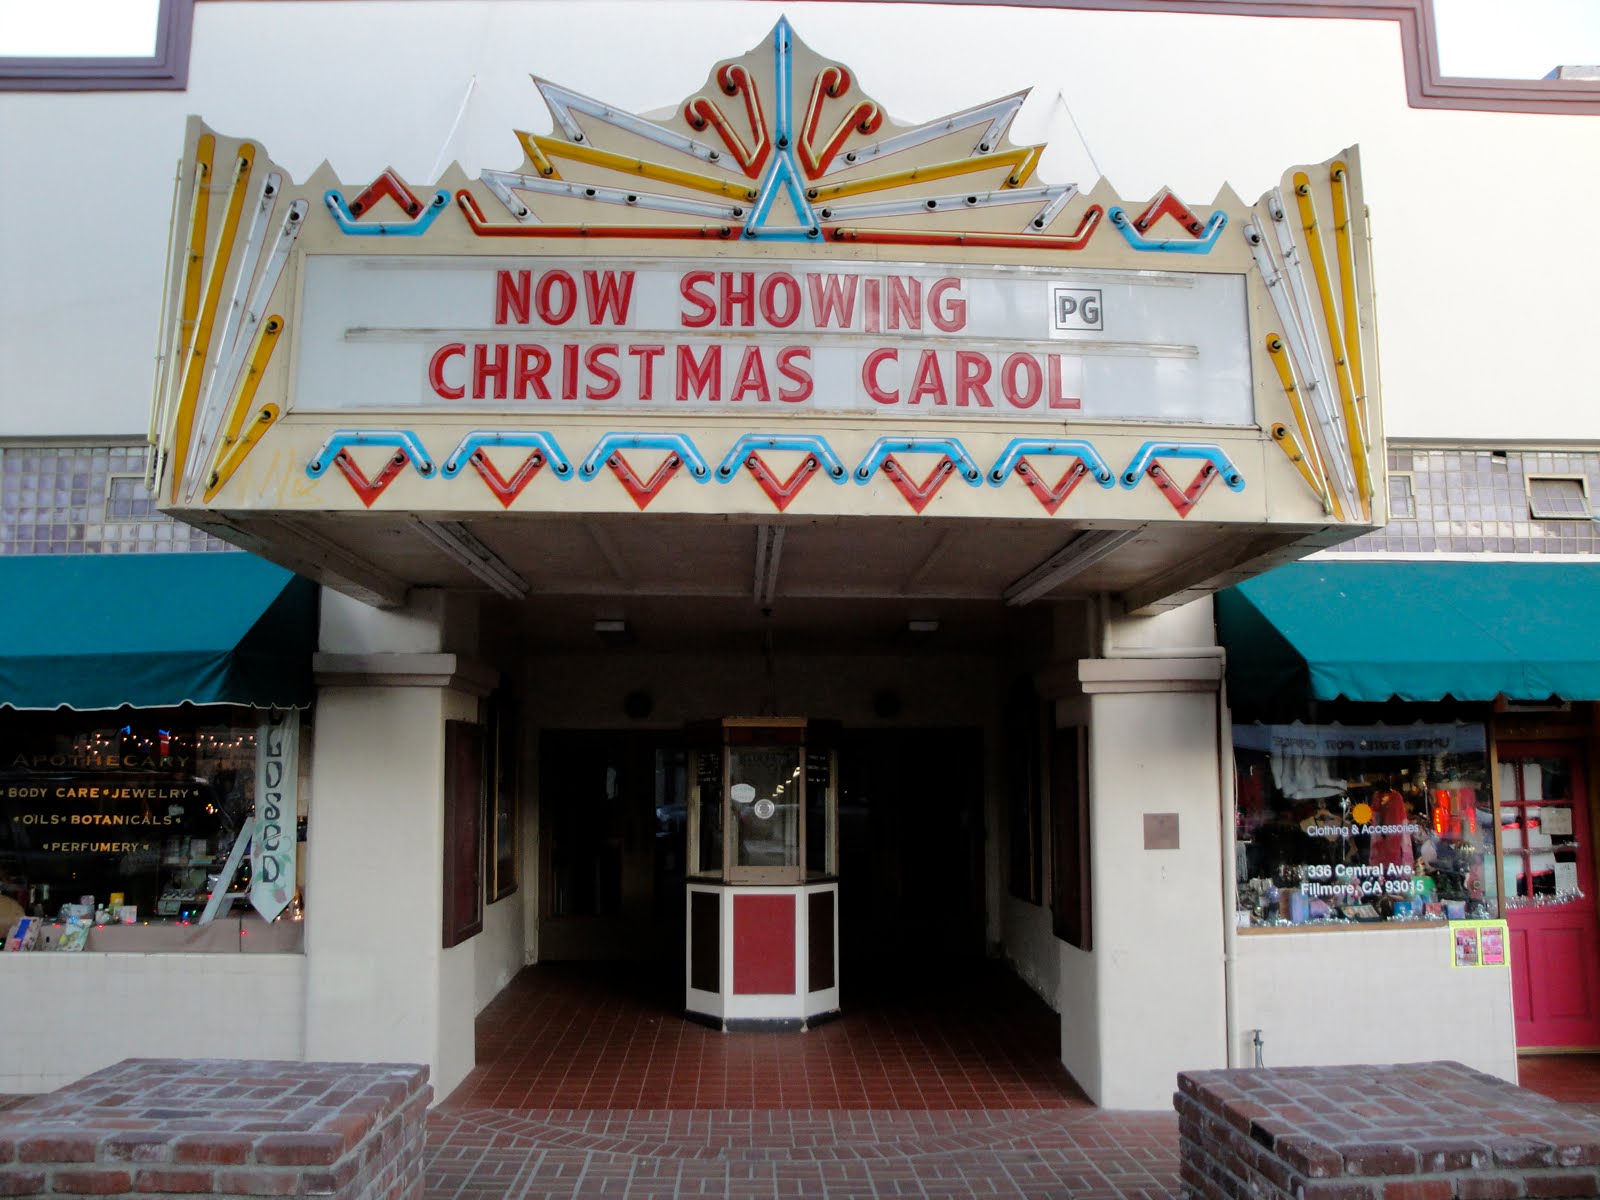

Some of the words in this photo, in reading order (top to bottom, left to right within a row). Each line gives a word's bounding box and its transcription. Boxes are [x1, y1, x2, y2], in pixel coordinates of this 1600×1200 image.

[495, 270, 635, 326] NOW
[679, 270, 967, 334] SHOWING
[1058, 295, 1099, 325] PG
[428, 343, 814, 403] CHRISTMAS
[861, 347, 1081, 410] CAROL
[12, 752, 191, 768] APOTHECARY
[8, 787, 48, 798] BODY
[56, 787, 100, 798] CARE
[111, 788, 189, 798] JEWELRY
[22, 814, 60, 825] OILS
[71, 814, 172, 825] BOTANICALS
[1307, 825, 1349, 836] Clothing
[1351, 824, 1360, 835] &
[1361, 823, 1419, 834] Accessories
[51, 842, 139, 852] PERFUMERY
[1308, 865, 1332, 877] 336
[1335, 864, 1384, 877] Central
[1386, 863, 1415, 875] Ave.
[1301, 882, 1358, 896] Fillmore,
[1362, 880, 1382, 893] CA
[1385, 880, 1425, 893] 93015
